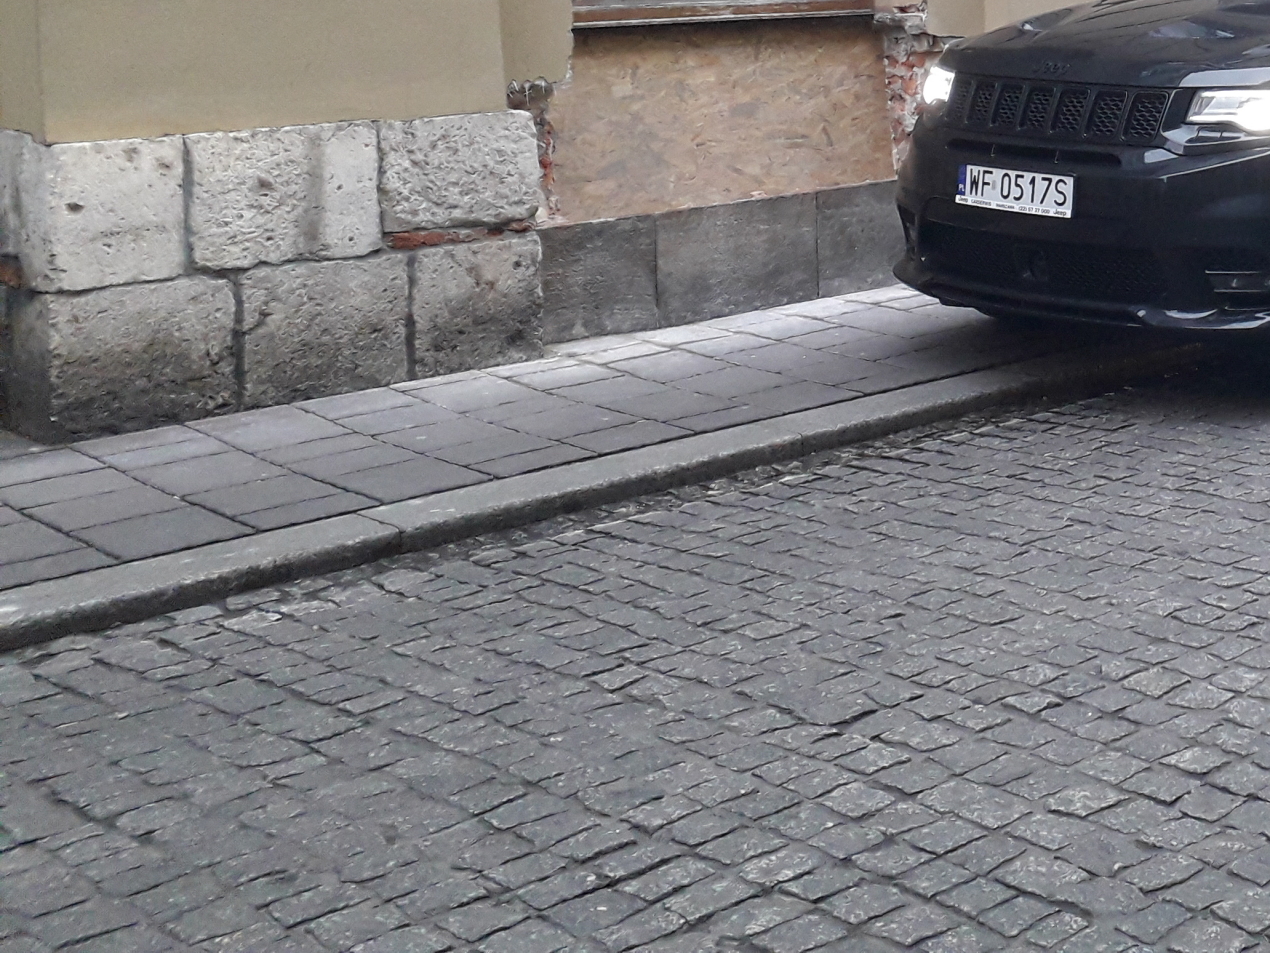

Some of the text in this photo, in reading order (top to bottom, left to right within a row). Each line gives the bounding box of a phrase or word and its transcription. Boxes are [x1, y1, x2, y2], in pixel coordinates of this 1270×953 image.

[958, 184, 965, 192] PL
[969, 168, 1068, 207] WF 0517S
[958, 196, 968, 204] Jeep
[1053, 209, 1067, 217] Jeep
